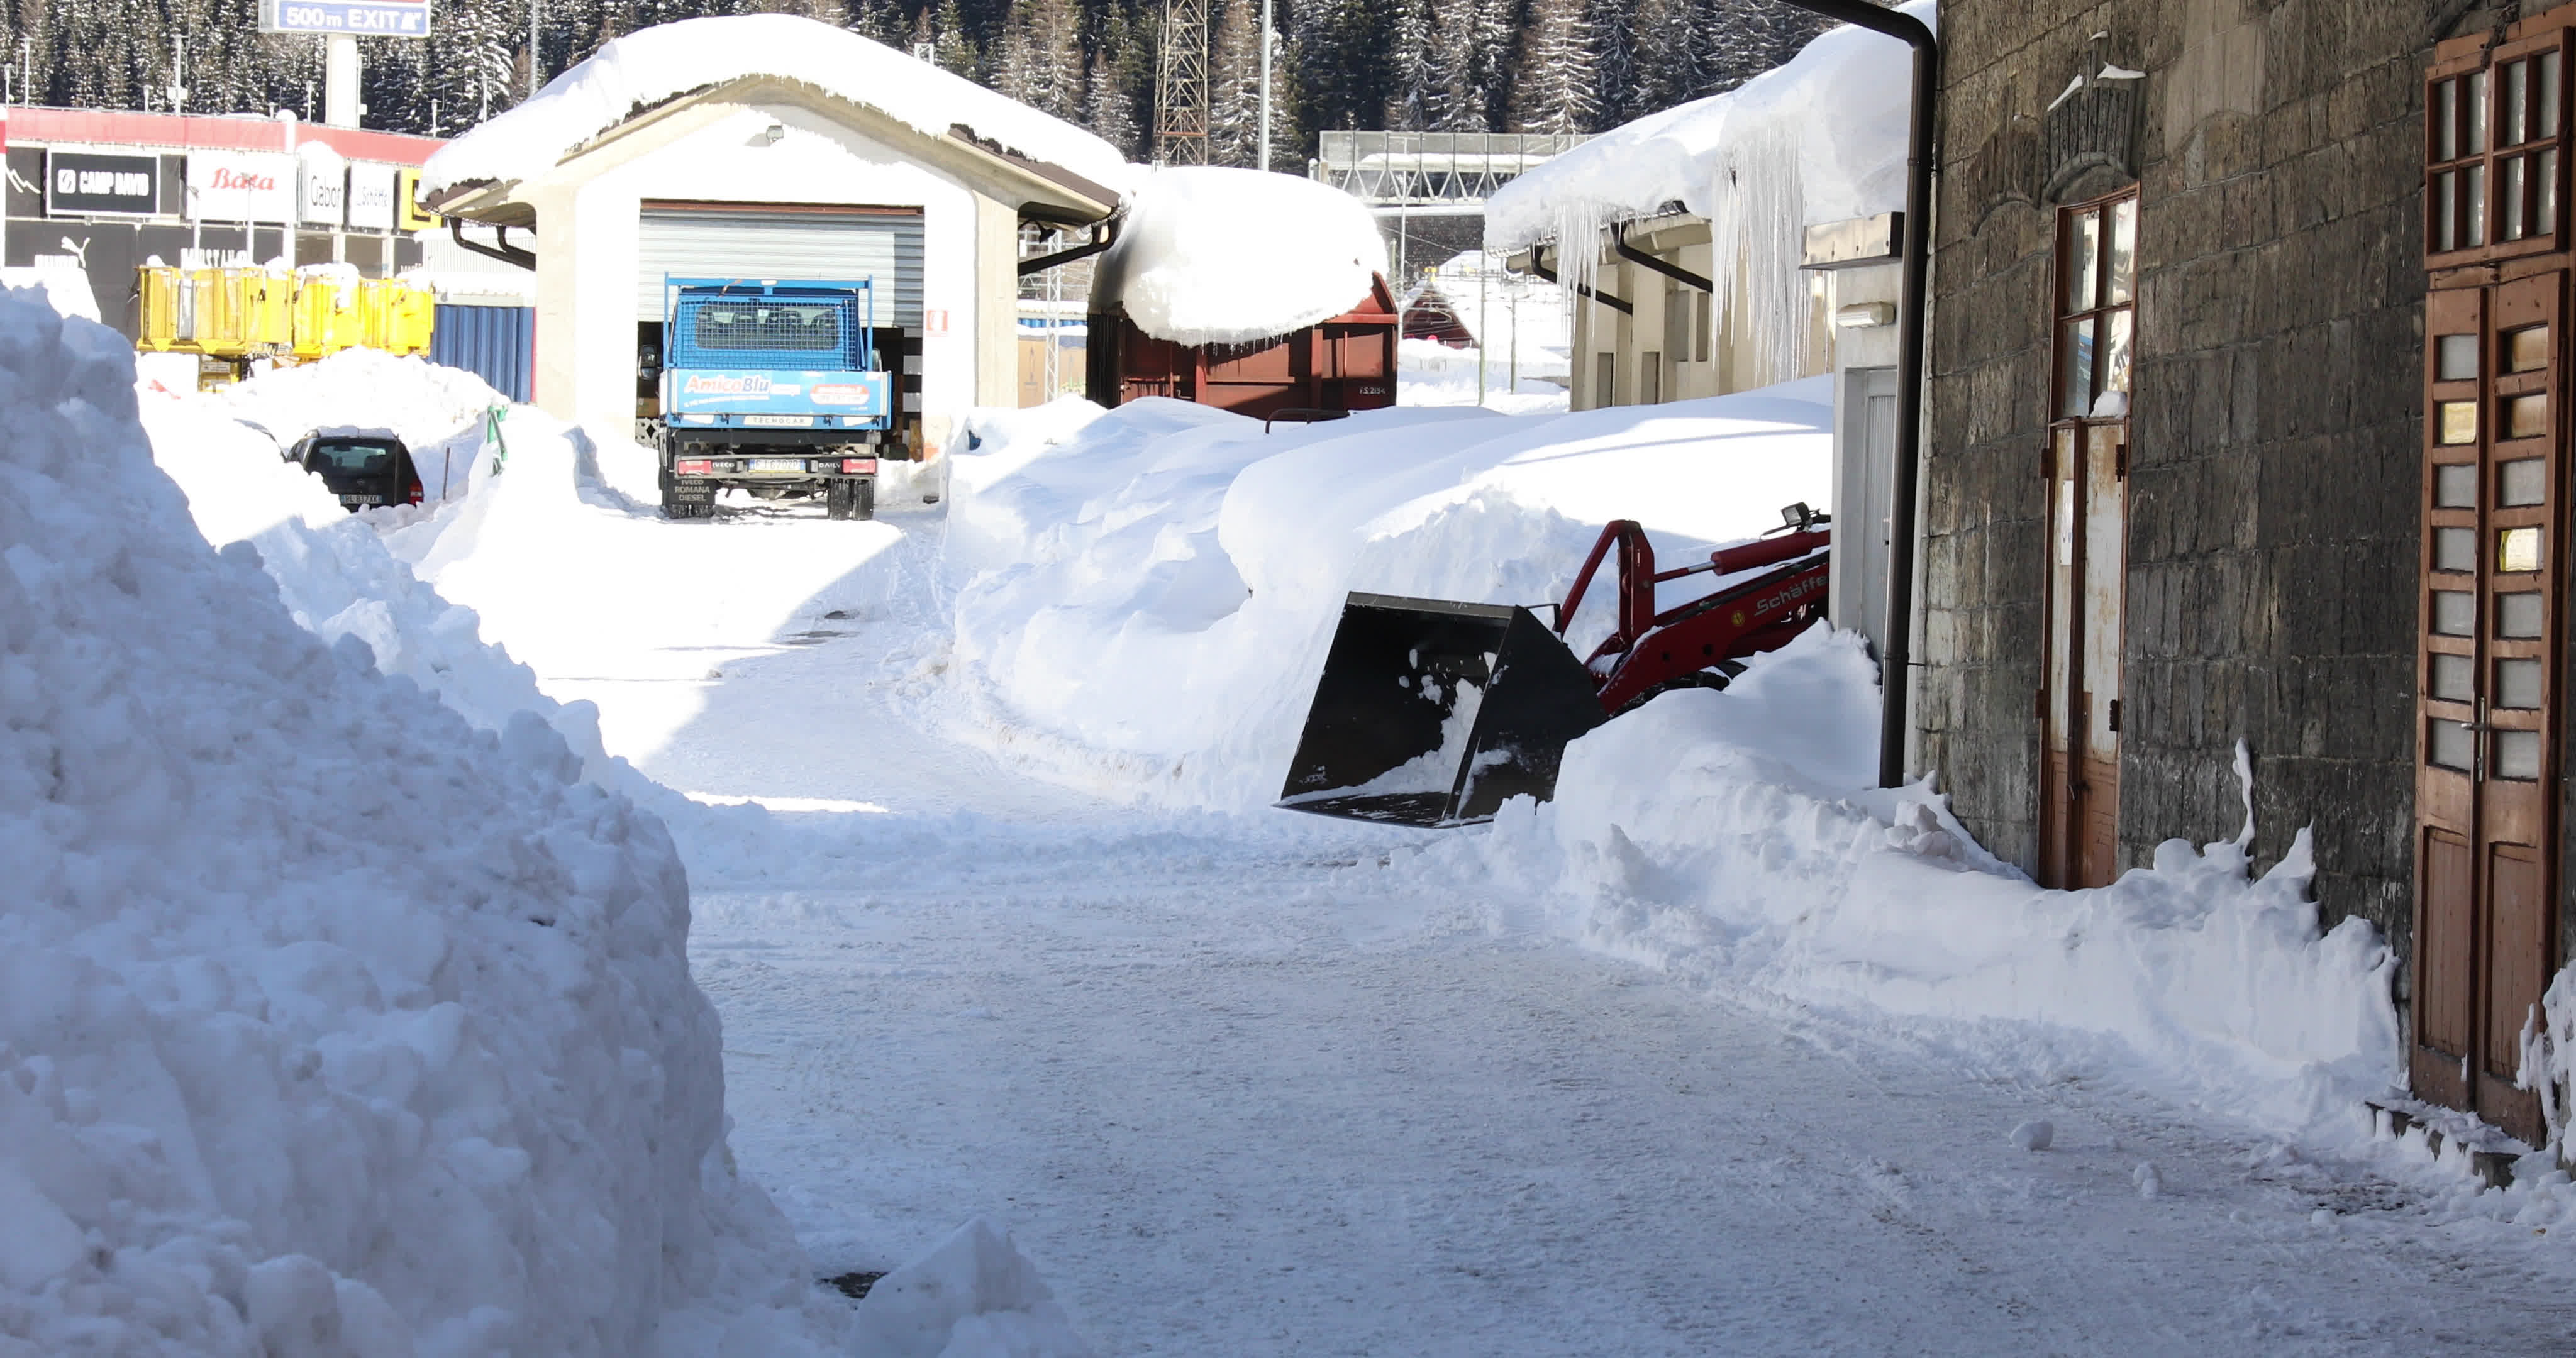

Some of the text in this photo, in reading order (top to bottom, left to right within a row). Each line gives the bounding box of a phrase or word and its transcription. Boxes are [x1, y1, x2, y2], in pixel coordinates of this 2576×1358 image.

[347, 8, 399, 30] EXIT
[79, 170, 150, 196] CAMP DAVID
[211, 167, 275, 190] Bata
[311, 175, 342, 207] Gabor
[687, 375, 770, 392] AmicoBlu
[753, 416, 805, 424] TECNOCAR
[674, 485, 711, 494] ROMANA
[679, 494, 706, 502] DIESEL
